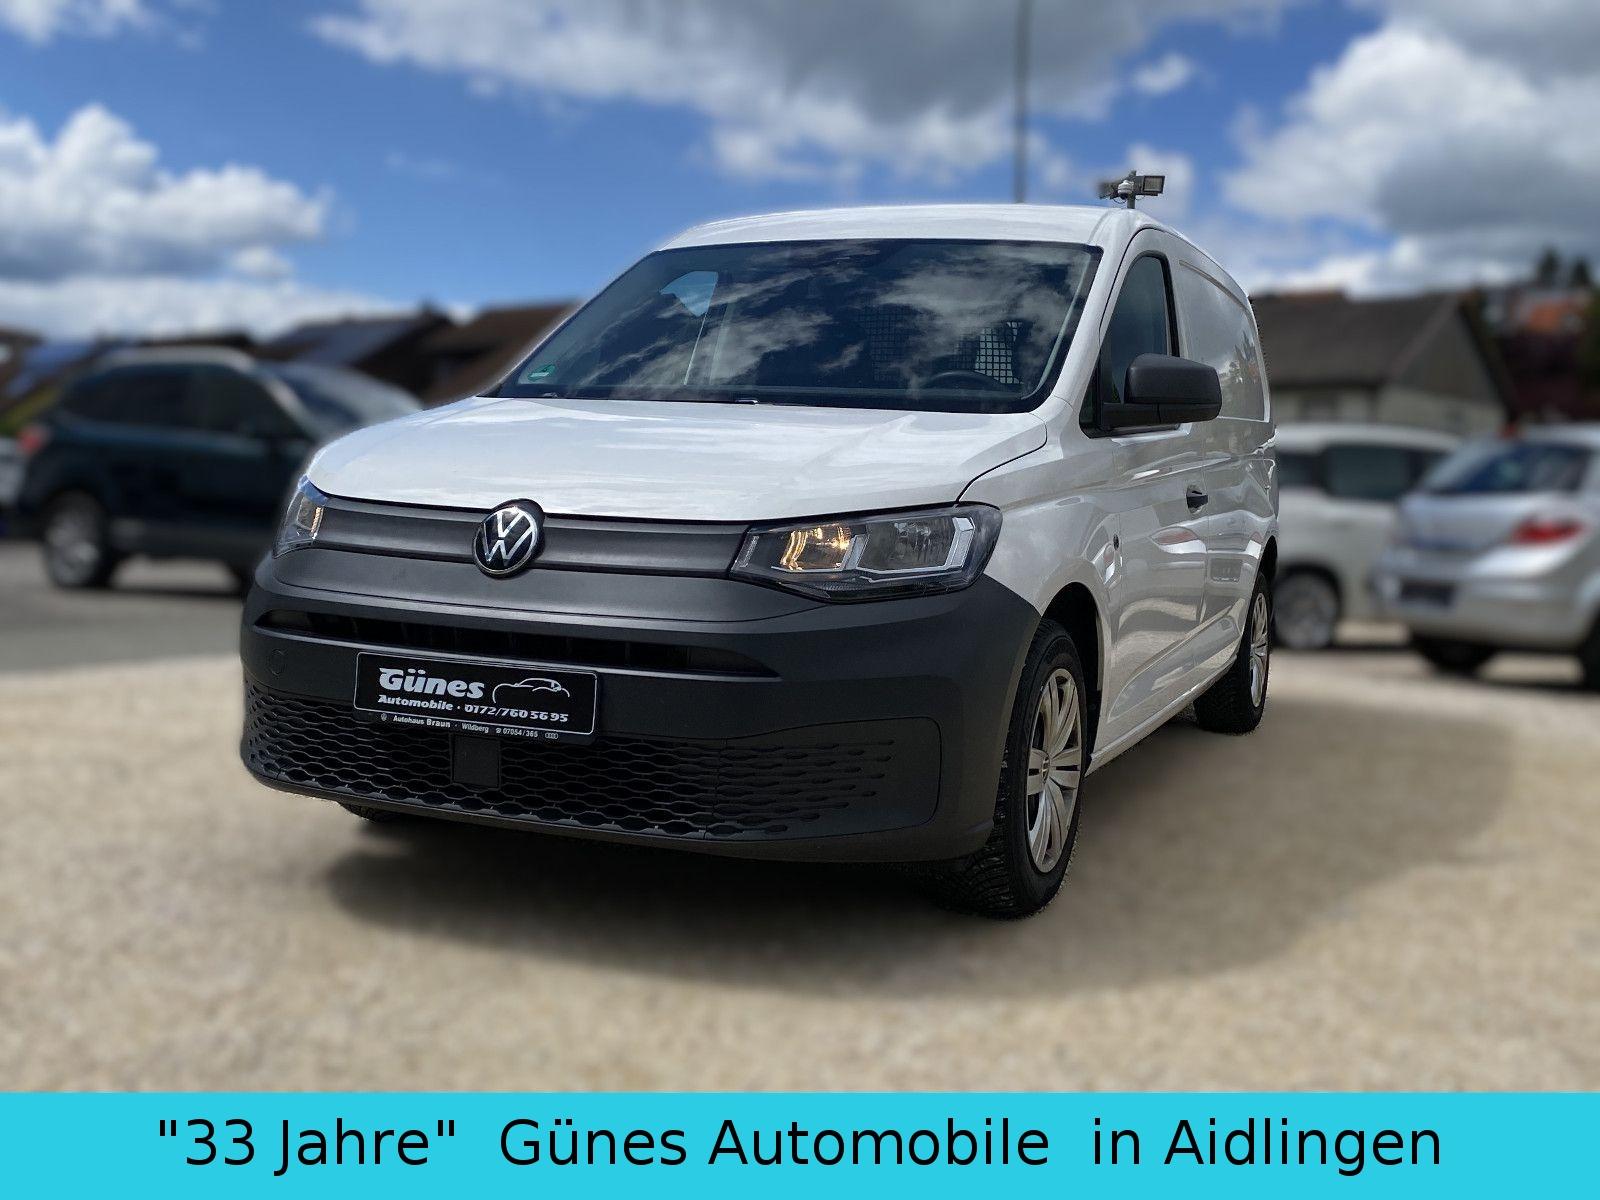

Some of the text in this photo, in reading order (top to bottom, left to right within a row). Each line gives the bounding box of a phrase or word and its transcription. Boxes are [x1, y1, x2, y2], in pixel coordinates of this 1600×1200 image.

[379, 667, 484, 699] Günes
[378, 694, 569, 723] Automobile 0172/760 56 95
[393, 715, 425, 725] Autohaus
[426, 718, 451, 728] Braun
[461, 722, 490, 734] Wildberg
